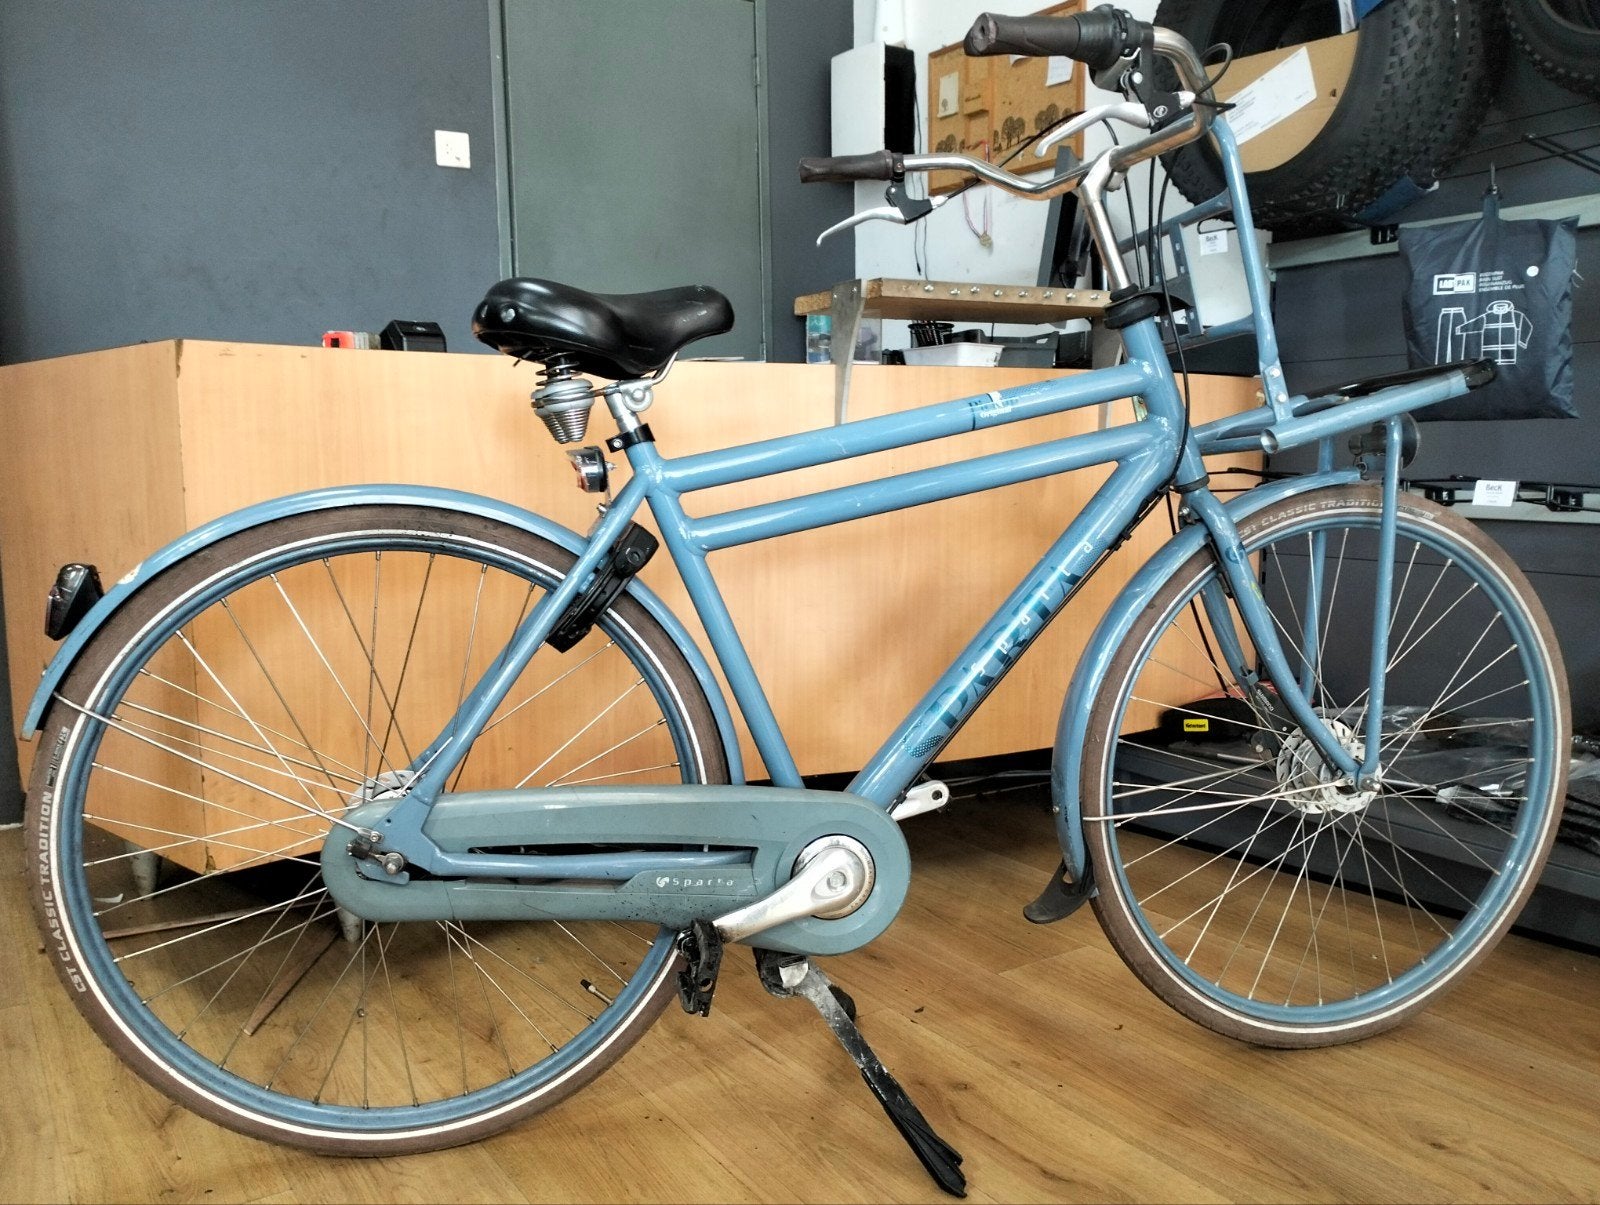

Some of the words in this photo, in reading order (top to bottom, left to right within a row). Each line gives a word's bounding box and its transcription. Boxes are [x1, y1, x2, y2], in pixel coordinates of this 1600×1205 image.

[1456, 279, 1471, 287] PAK
[1260, 502, 1317, 527] CLASSIC
[38, 791, 53, 886] TRADITION
[40, 889, 73, 968] CLASSIC
[65, 966, 87, 994] CST
